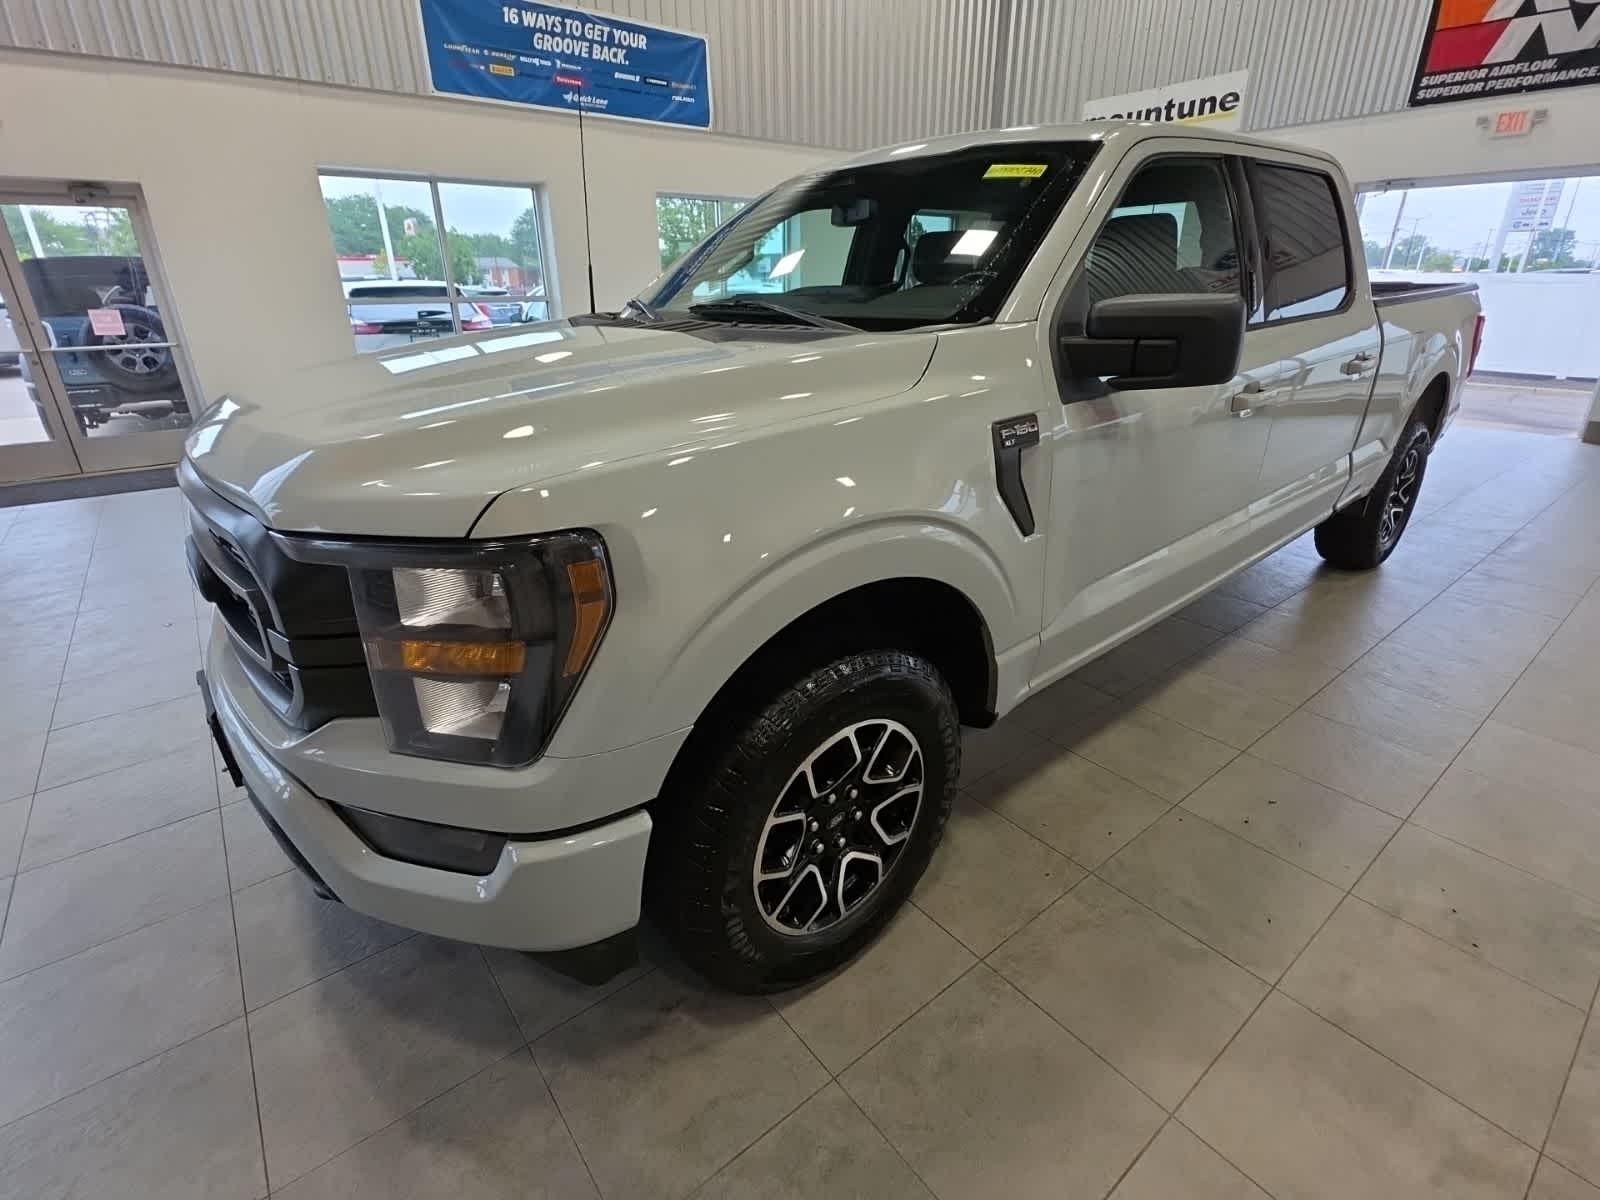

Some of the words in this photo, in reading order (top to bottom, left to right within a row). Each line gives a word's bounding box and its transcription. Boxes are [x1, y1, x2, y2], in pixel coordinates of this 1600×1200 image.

[503, 7, 519, 25] 16
[522, 10, 562, 34] WAYS
[564, 18, 583, 37] TO
[585, 23, 610, 42] GET
[612, 28, 647, 50] YOUR
[533, 32, 590, 57] GROOVE
[592, 44, 629, 65] BACK.
[1420, 68, 1489, 87] SUPERIOR
[1490, 58, 1558, 78] AIRFLOW.
[1416, 82, 1483, 100] SUPERIOR
[1495, 112, 1528, 133] EXIT
